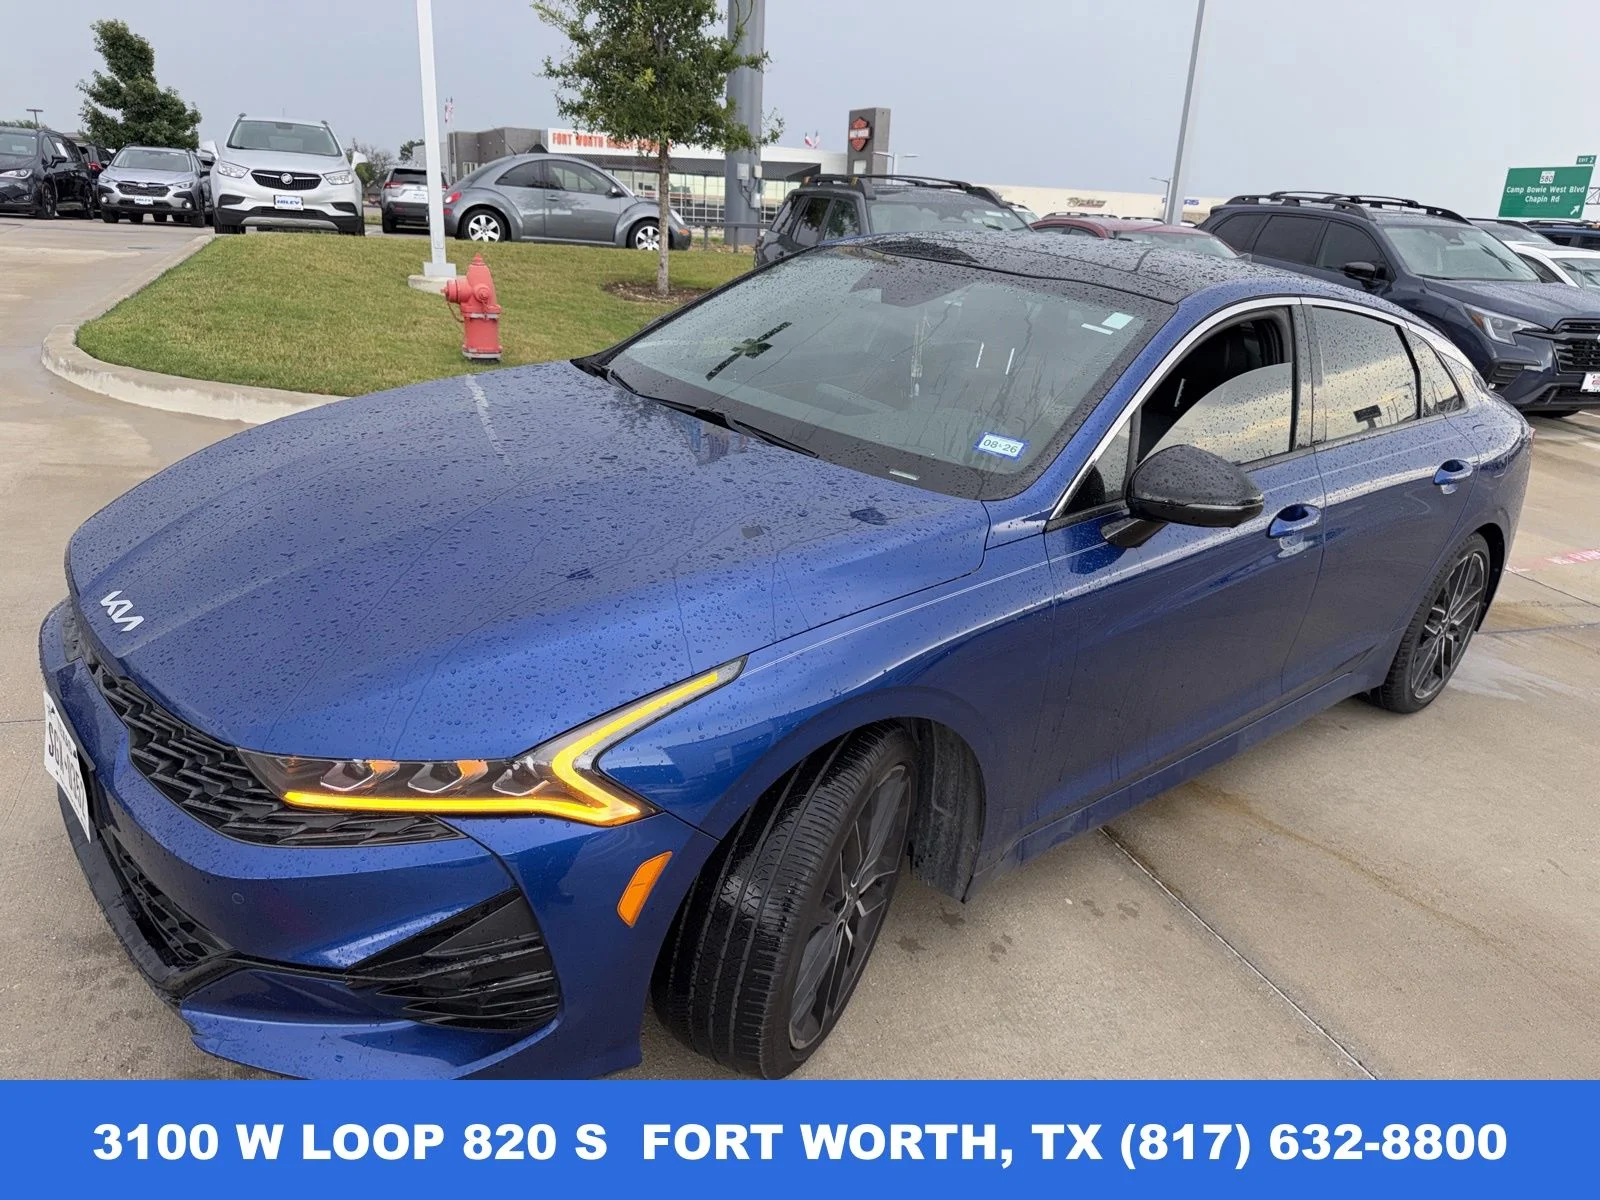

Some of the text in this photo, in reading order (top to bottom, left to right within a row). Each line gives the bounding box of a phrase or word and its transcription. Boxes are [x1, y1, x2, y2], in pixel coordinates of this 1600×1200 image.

[552, 132, 572, 145] FORT
[576, 134, 603, 148] WORTH
[1541, 175, 1554, 183] 580
[1506, 186, 1525, 194] Camp
[1524, 195, 1561, 204] Chapin Rd
